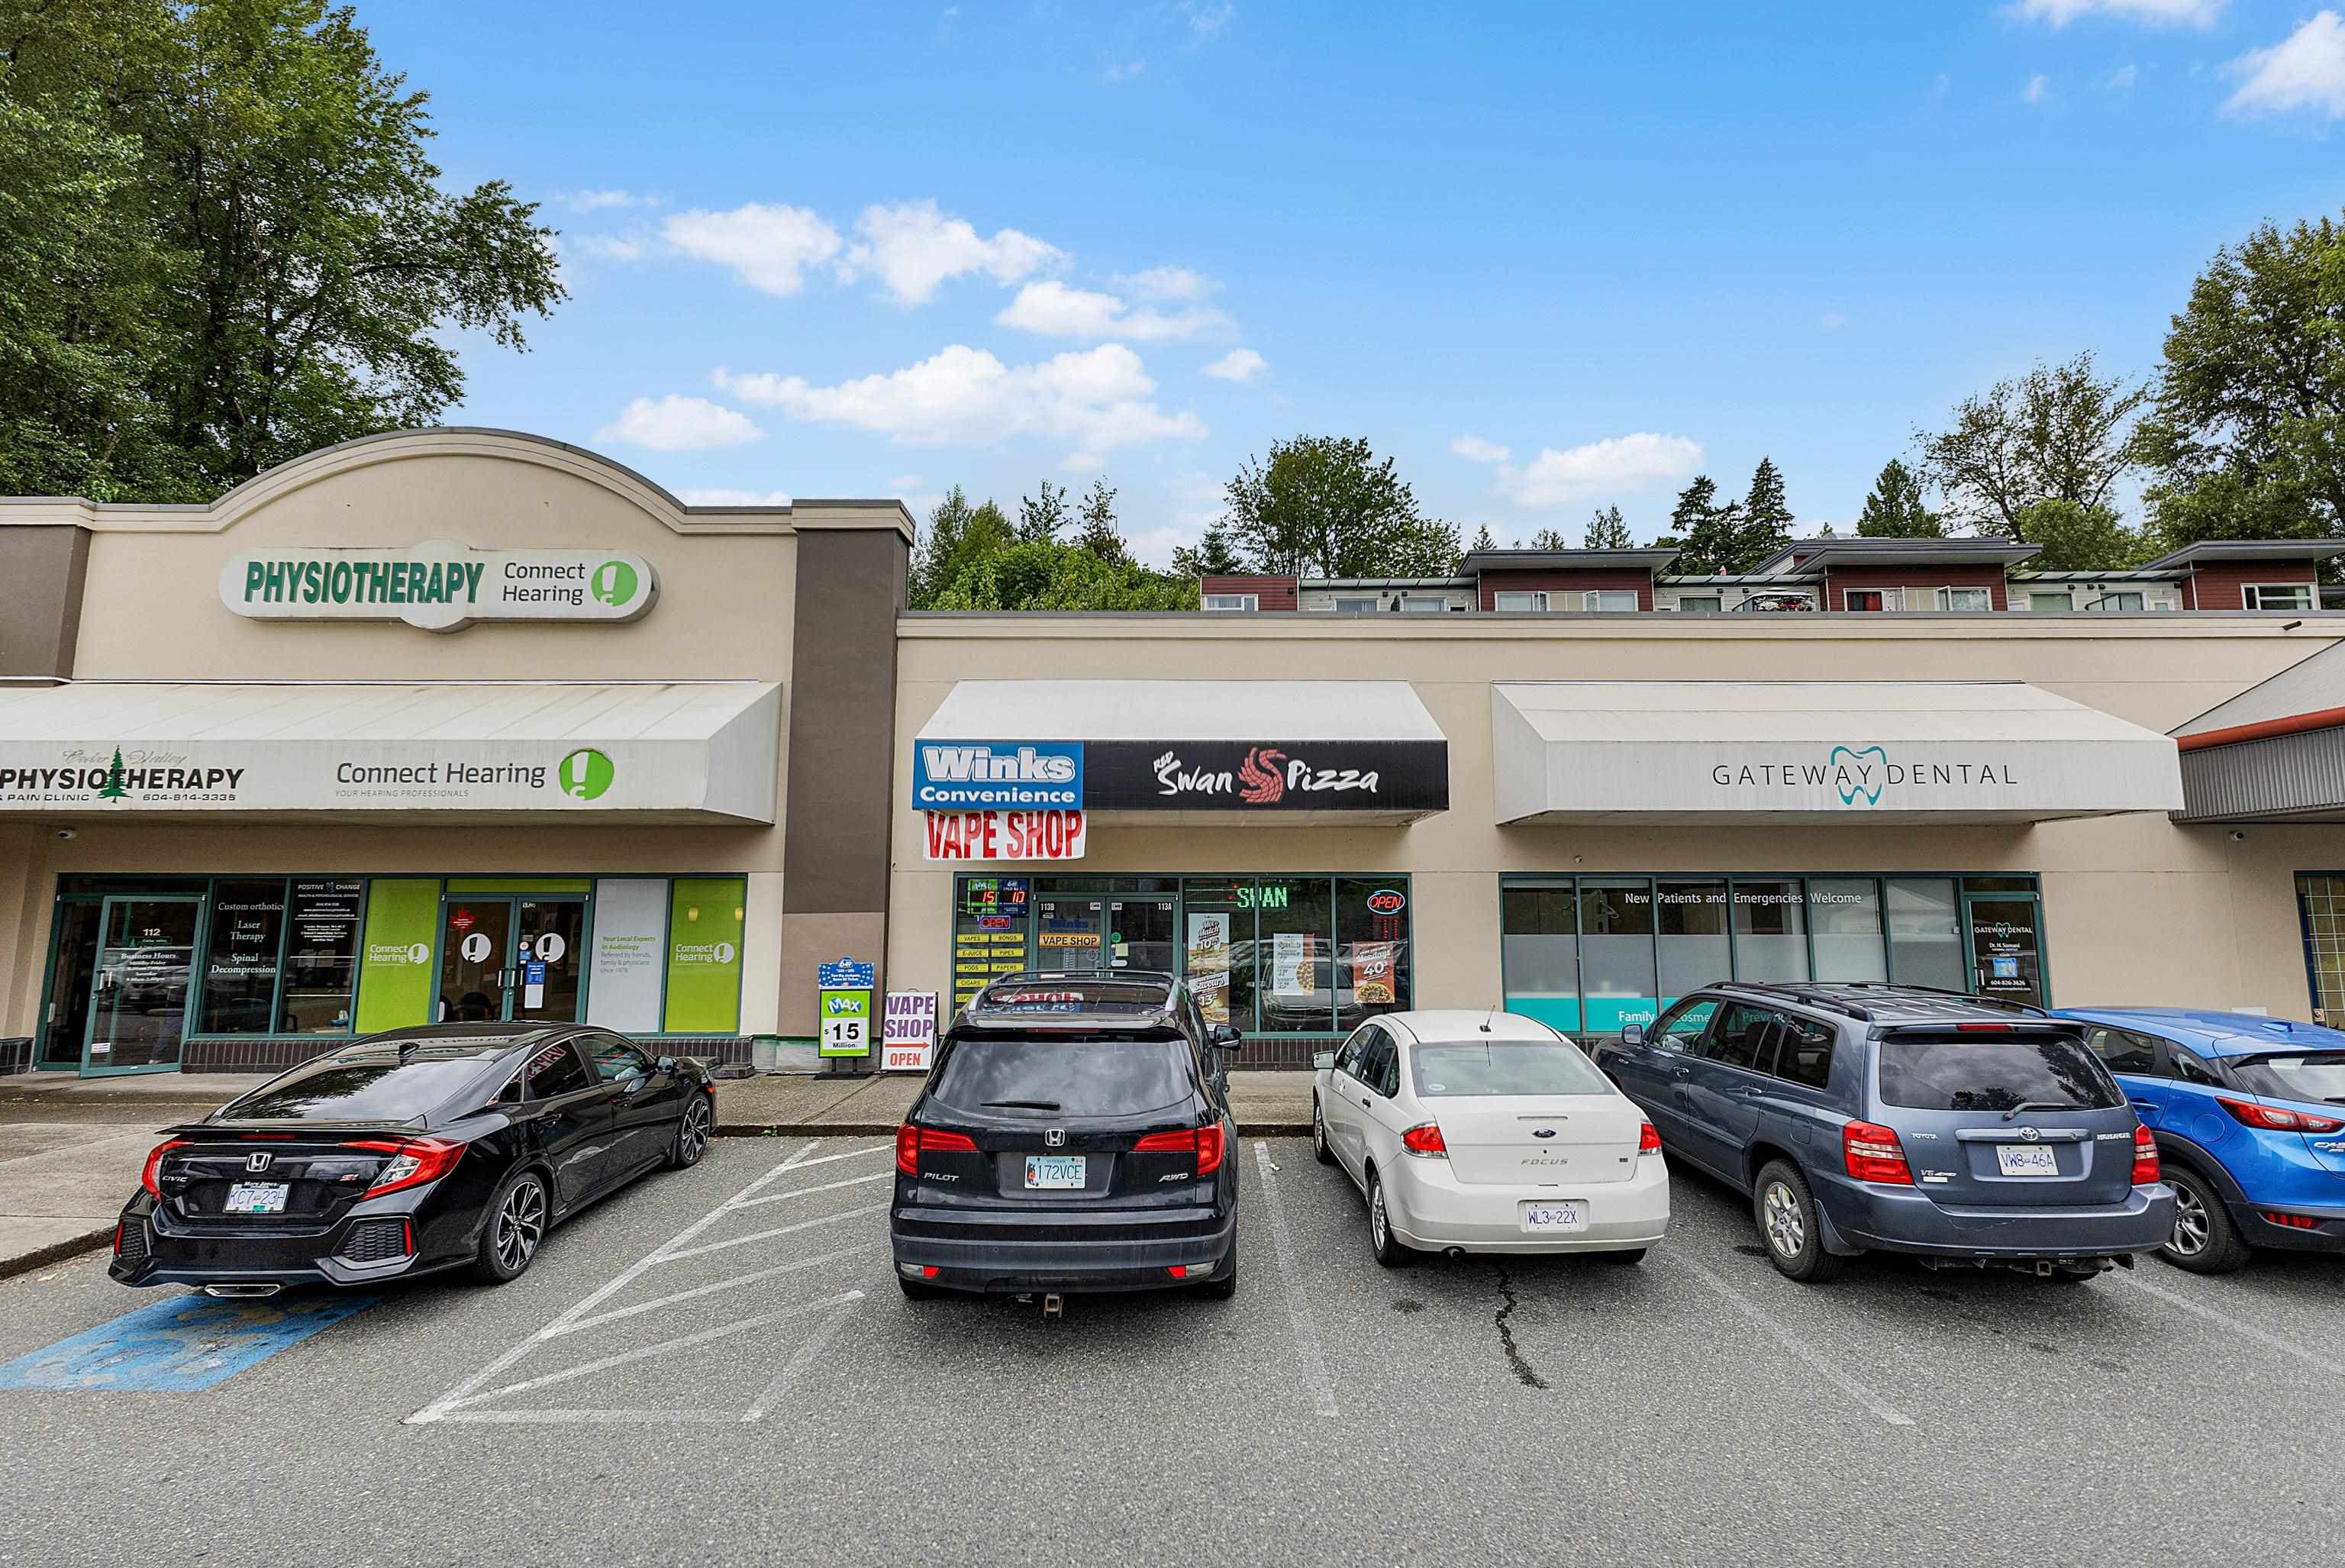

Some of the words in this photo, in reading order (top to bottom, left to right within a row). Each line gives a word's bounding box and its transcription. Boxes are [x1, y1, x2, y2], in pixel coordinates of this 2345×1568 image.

[505, 563, 585, 579] Connect
[244, 561, 485, 605] PHYSIOTHERAPY
[502, 586, 584, 605] Hearing
[63, 749, 110, 764] Cedar
[127, 750, 189, 765] Valley
[922, 746, 1076, 783] Winks
[337, 763, 438, 784] Connect
[446, 763, 547, 788] Hearing
[1156, 760, 1233, 795] Swan
[1287, 760, 1379, 793] Pizza
[1712, 764, 1872, 785] GATEWAY
[1886, 764, 2018, 784] DENTAL
[335, 789, 358, 798] YOUR
[360, 789, 399, 798] HEARING
[401, 789, 469, 798] PROFESSIONALS
[920, 786, 1076, 803] Convenience
[926, 811, 998, 859] VAPE
[1006, 810, 1083, 859] SHOP
[982, 891, 995, 903] 15
[1369, 895, 1402, 908] OPEN
[1625, 893, 1650, 904] New
[1657, 893, 1701, 904] Patients
[1705, 892, 1727, 904] and
[1734, 893, 1803, 906] Emergencies
[1810, 892, 1862, 904] Welcome
[218, 902, 249, 911] Custom
[250, 902, 285, 911] orthotics
[237, 920, 261, 929] Laser
[982, 918, 1008, 928] OPEN
[230, 931, 266, 943] Therapy
[1043, 936, 1068, 946] VAPE
[1070, 936, 1097, 946] SHOP
[370, 944, 408, 953] Connect
[676, 944, 714, 953] Connect
[231, 953, 259, 964] Spinal
[369, 953, 407, 963] Hearing
[676, 953, 713, 963] Hearing
[211, 965, 276, 976] Decompression
[828, 997, 862, 1014] MAX
[888, 995, 934, 1015] VAPE
[1618, 1011, 1656, 1024] Family
[885, 1019, 934, 1037] SHOP
[890, 1053, 921, 1066] OPEN
[924, 1172, 959, 1182] PILOT
[1039, 1165, 1082, 1179] 172VCE
[1159, 1173, 1190, 1182] AWD
